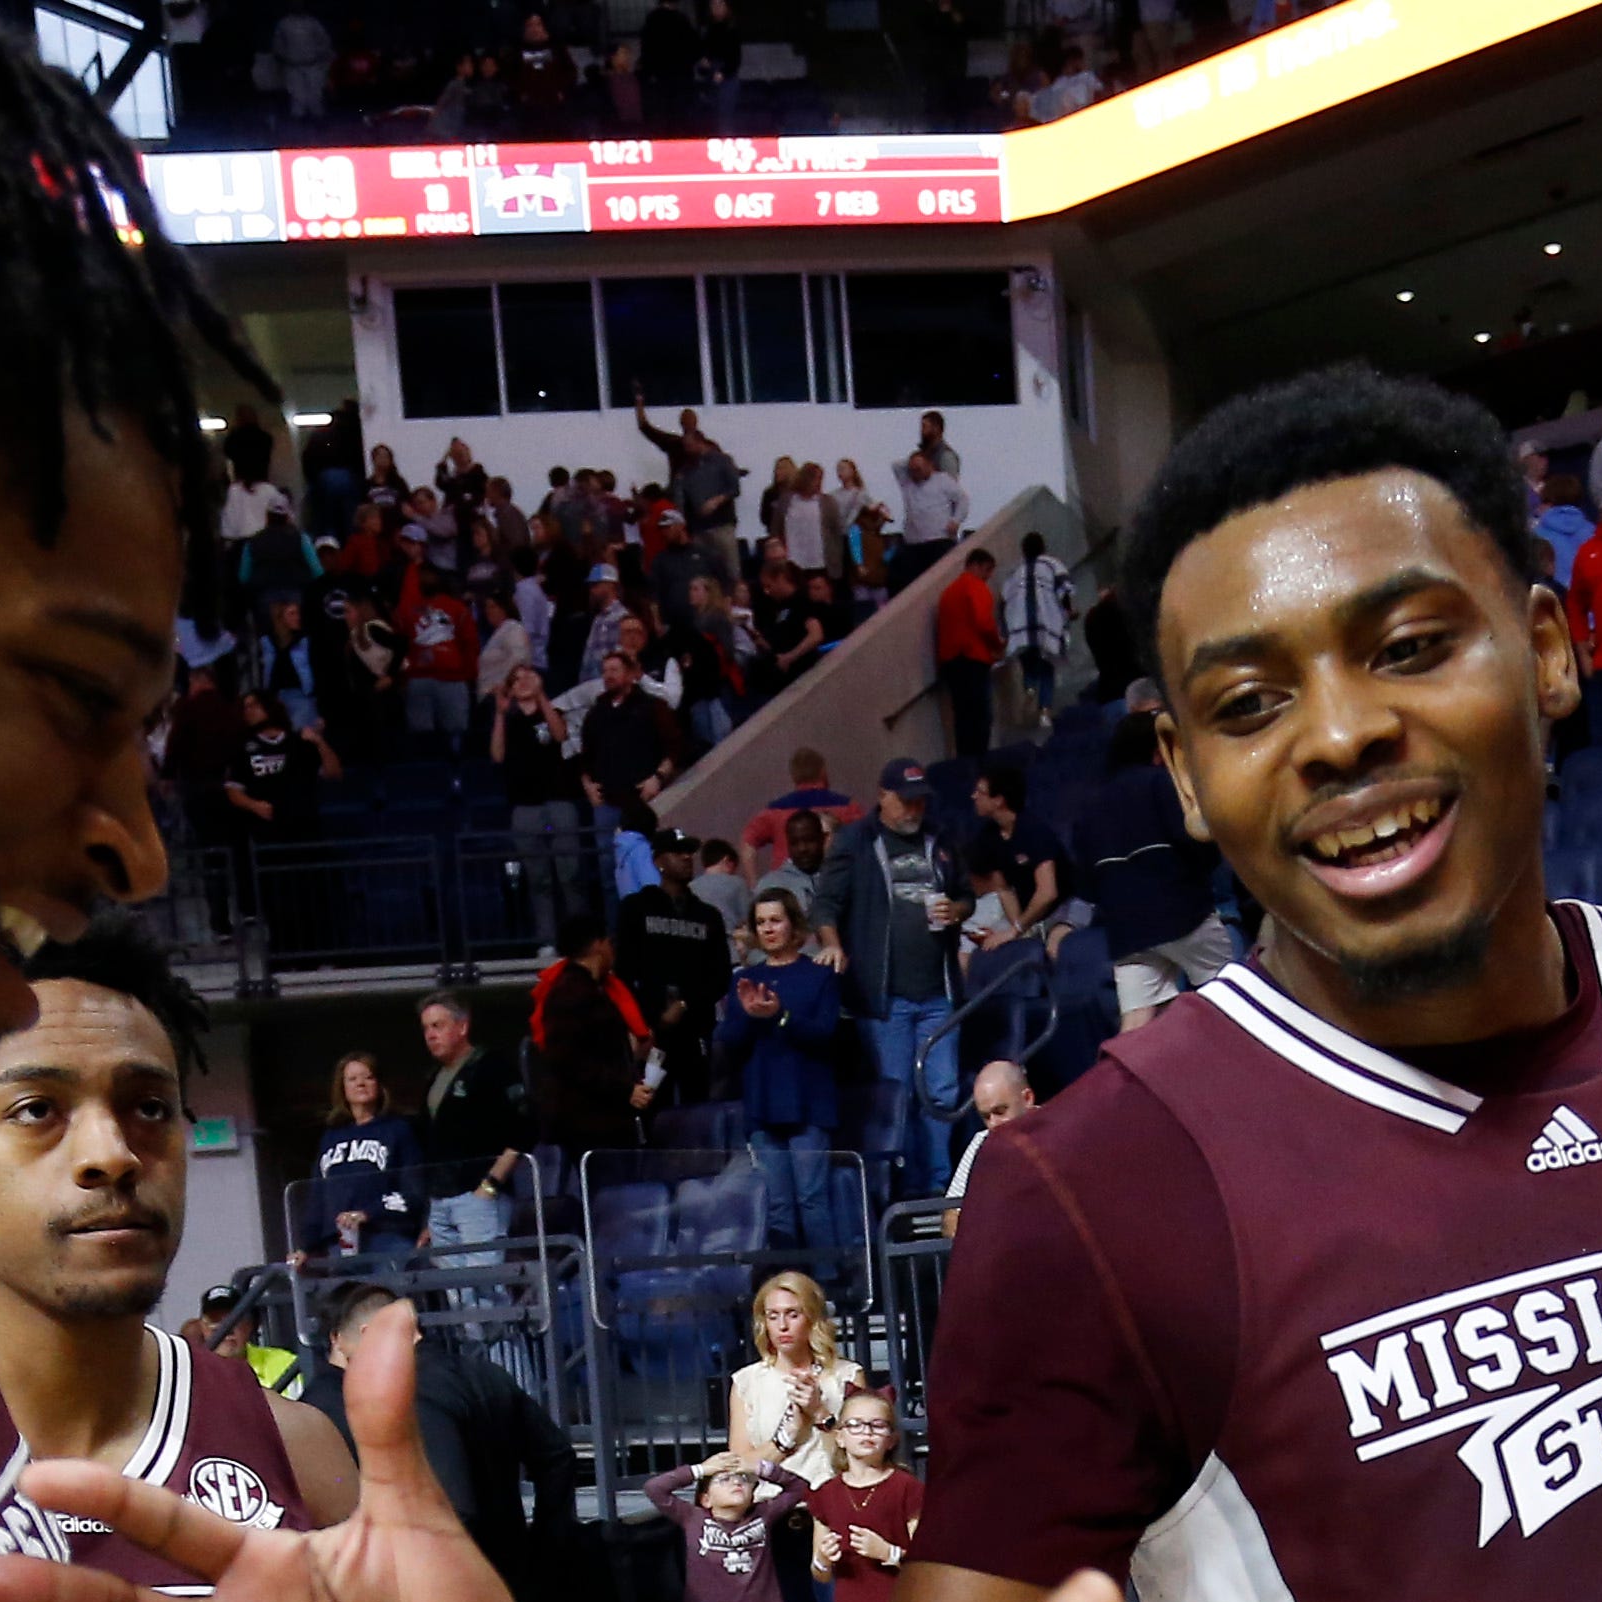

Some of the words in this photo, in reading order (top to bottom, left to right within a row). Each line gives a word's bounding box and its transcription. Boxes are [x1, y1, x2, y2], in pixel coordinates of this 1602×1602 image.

[605, 196, 637, 221] 10
[639, 195, 680, 220] PTS
[715, 194, 732, 218] 0
[734, 193, 774, 217] AST
[815, 192, 831, 216] 7
[918, 189, 935, 215] 0
[938, 189, 977, 214] FLS
[348, 1139, 388, 1171] MISS
[197, 1462, 260, 1521] SEC
